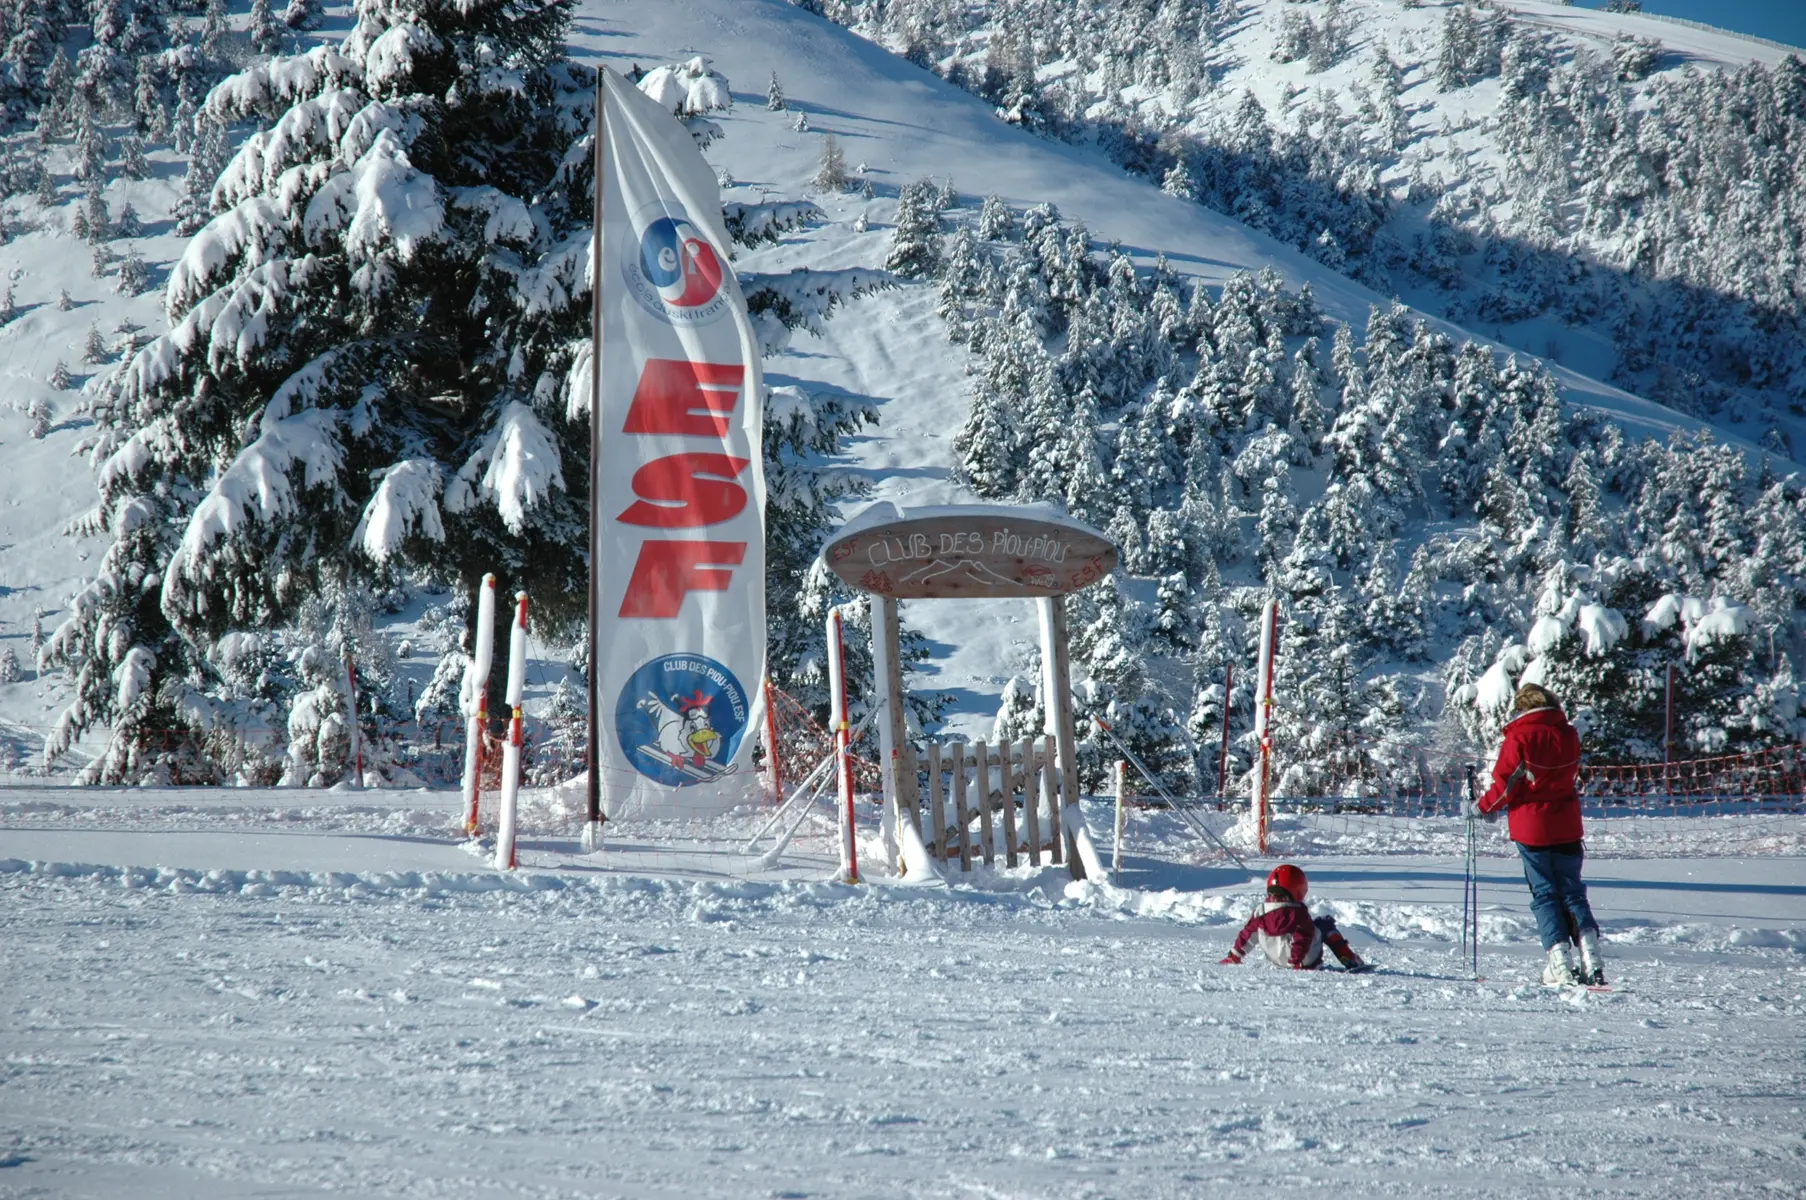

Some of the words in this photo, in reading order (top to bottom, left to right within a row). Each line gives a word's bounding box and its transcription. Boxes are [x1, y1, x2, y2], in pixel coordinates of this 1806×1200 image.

[672, 309, 692, 320] ski
[615, 358, 751, 618] ESF
[832, 537, 858, 561] ESF
[868, 533, 932, 567] CLUB
[940, 532, 985, 554] DES
[1072, 556, 1103, 588] ESF
[663, 660, 687, 672] CLUB
[688, 661, 707, 675] DES
